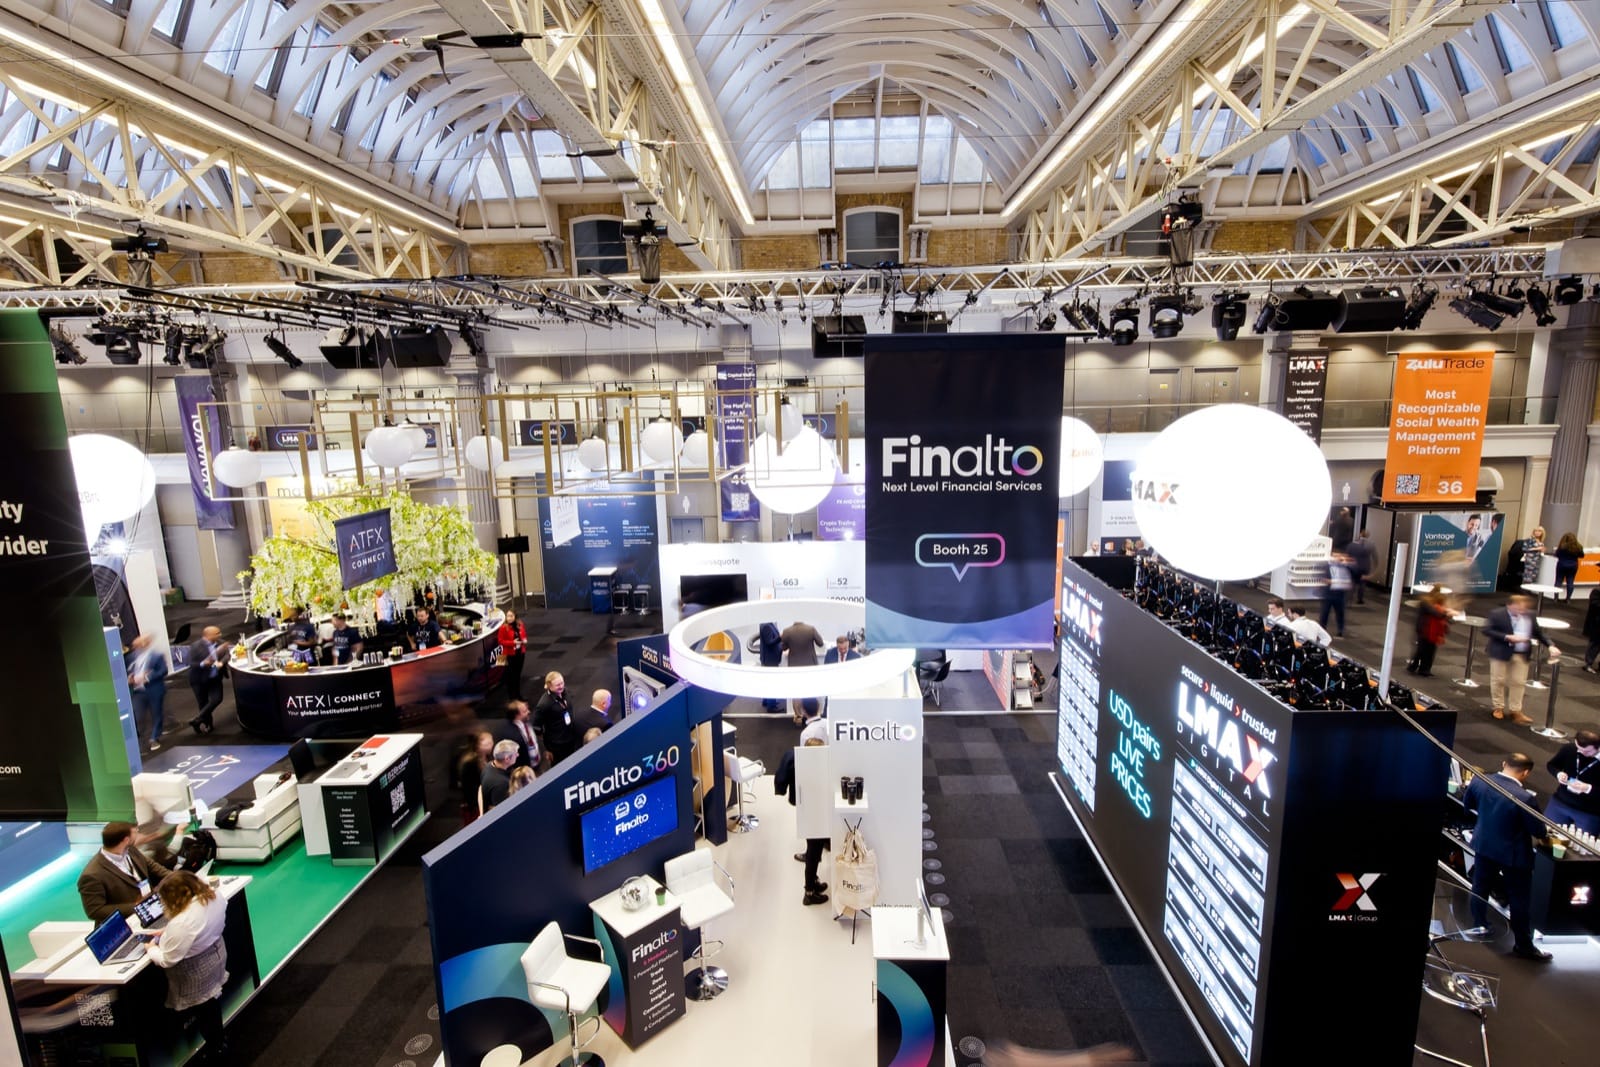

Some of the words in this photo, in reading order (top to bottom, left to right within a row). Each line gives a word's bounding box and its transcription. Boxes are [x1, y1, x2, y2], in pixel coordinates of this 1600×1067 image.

[1289, 360, 1325, 370] LMAX
[1405, 357, 1485, 371] ZuluTrade
[1425, 390, 1456, 400] Most
[1398, 402, 1481, 415] Recognizable
[1396, 417, 1433, 428] Social
[1437, 417, 1479, 427] Wealth
[1396, 431, 1476, 443] Management
[882, 434, 1043, 477] Finalto
[1407, 445, 1461, 455] Platform
[882, 482, 907, 492] Next
[910, 482, 938, 492] Level
[942, 481, 993, 492] Financial
[995, 480, 1042, 491] Services
[1437, 481, 1463, 494] 36
[349, 526, 384, 552] ATFX
[933, 543, 970, 555] Booth
[973, 544, 988, 555] 25
[352, 552, 386, 570] CONNECT
[783, 578, 799, 586] 663
[837, 577, 848, 586] 52
[1062, 587, 1103, 646] LMAX
[642, 649, 658, 664] GOLD
[287, 695, 325, 708] ATFX
[334, 690, 382, 704] CONNECT
[1181, 665, 1204, 689] secure
[1210, 683, 1234, 712] liquid
[1242, 708, 1277, 744] trusted
[300, 709, 319, 717] global
[320, 706, 359, 715] institutional
[360, 703, 383, 711] partner
[835, 721, 917, 741] Finalto
[1109, 689, 1133, 728] USD
[1132, 719, 1160, 760] pairs
[1178, 681, 1275, 799] LMAX
[1119, 731, 1144, 778] LIVE
[1176, 720, 1270, 817] DIGITAL
[564, 745, 680, 811] Finalto360
[1111, 752, 1151, 818] PRICES
[615, 813, 649, 836] Finalto
[632, 929, 677, 963] Finalto
[637, 963, 658, 978] Powerful
[658, 950, 679, 965] Platform
